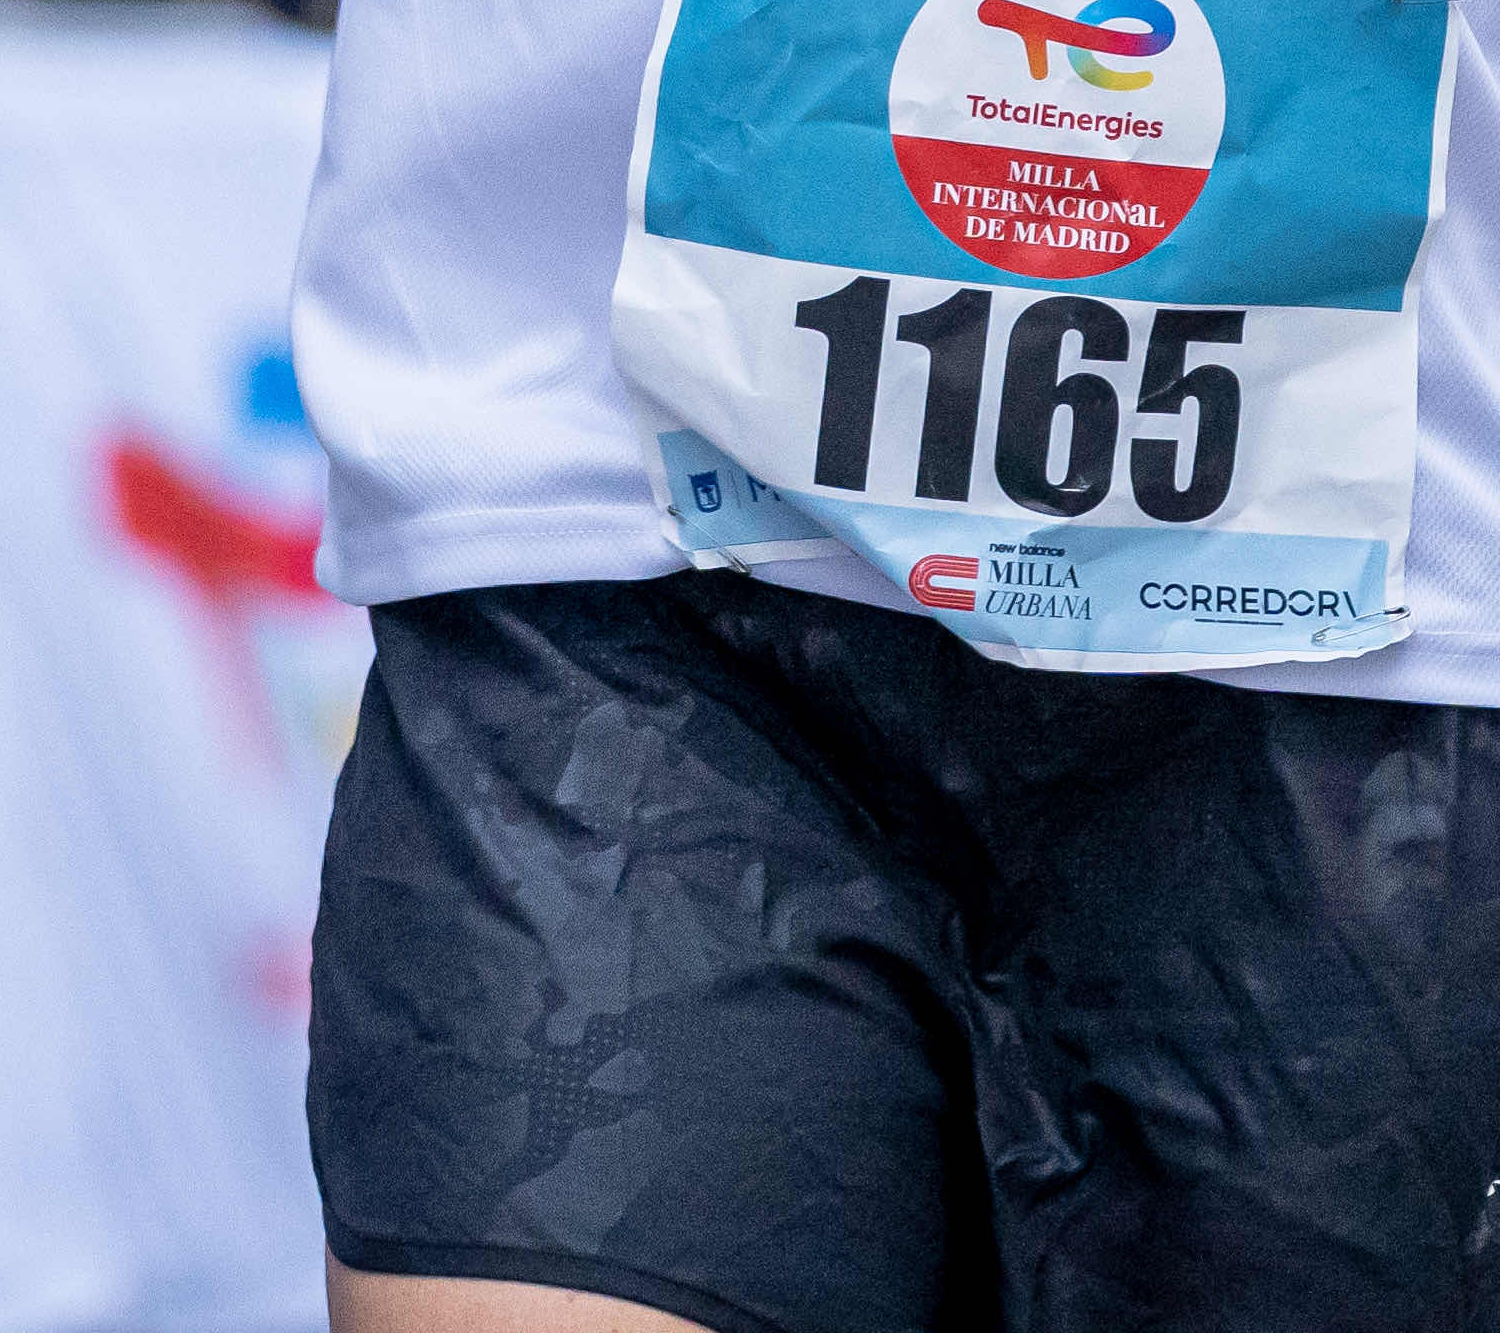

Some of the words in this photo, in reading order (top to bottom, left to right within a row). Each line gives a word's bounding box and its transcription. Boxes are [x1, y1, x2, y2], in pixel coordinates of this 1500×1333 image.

[966, 94, 1164, 141] TotalEnergies
[1007, 160, 1102, 192] MILLA
[964, 215, 1005, 241] DE
[1012, 220, 1131, 254] MADRID
[794, 275, 1247, 523] 1165
[989, 542, 1017, 554] new
[1019, 542, 1066, 558] balance
[987, 559, 1083, 589] MILLA
[985, 589, 1093, 621] URBANA
